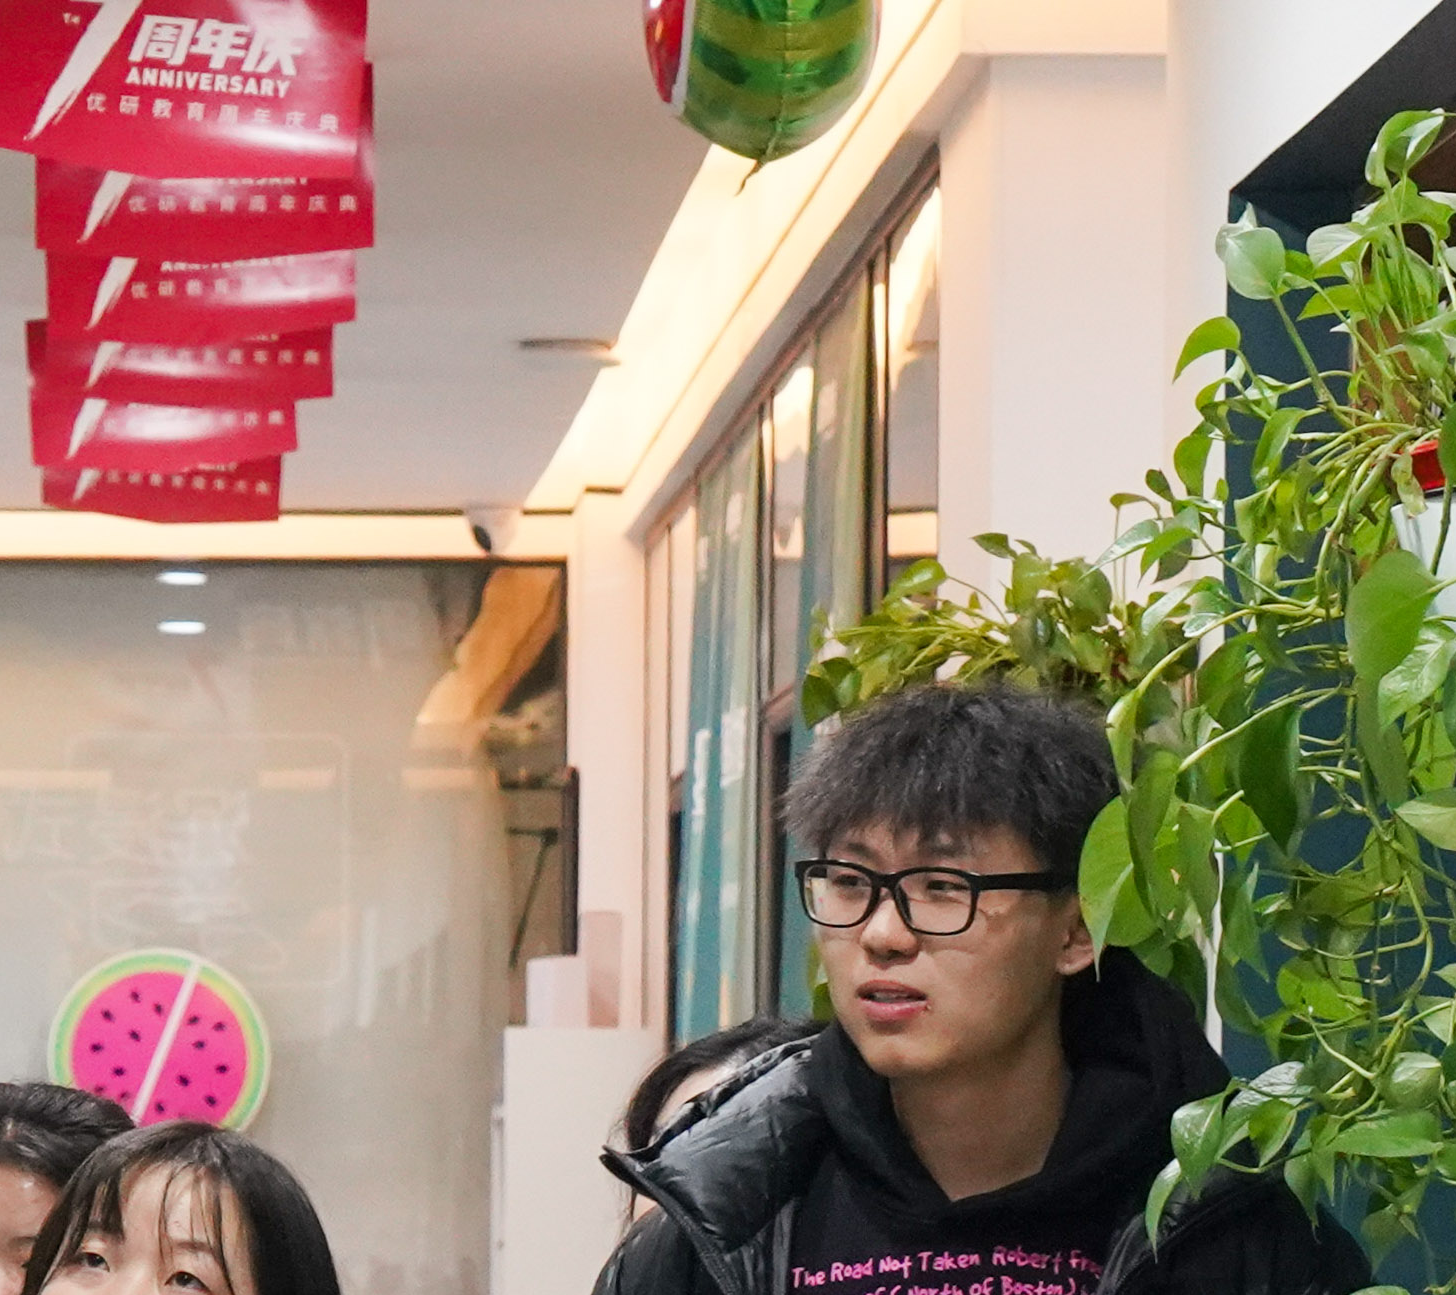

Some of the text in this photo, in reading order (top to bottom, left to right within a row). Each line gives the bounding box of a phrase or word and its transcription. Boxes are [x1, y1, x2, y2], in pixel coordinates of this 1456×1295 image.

[128, 14, 309, 77] 周年庆
[126, 66, 292, 98] ANNIVERSARY
[86, 92, 340, 132] 优研教育周年庆典
[792, 1267, 826, 1288] The
[830, 1258, 874, 1282] Road
[879, 1256, 912, 1279] Not
[918, 1251, 980, 1271] Taken
